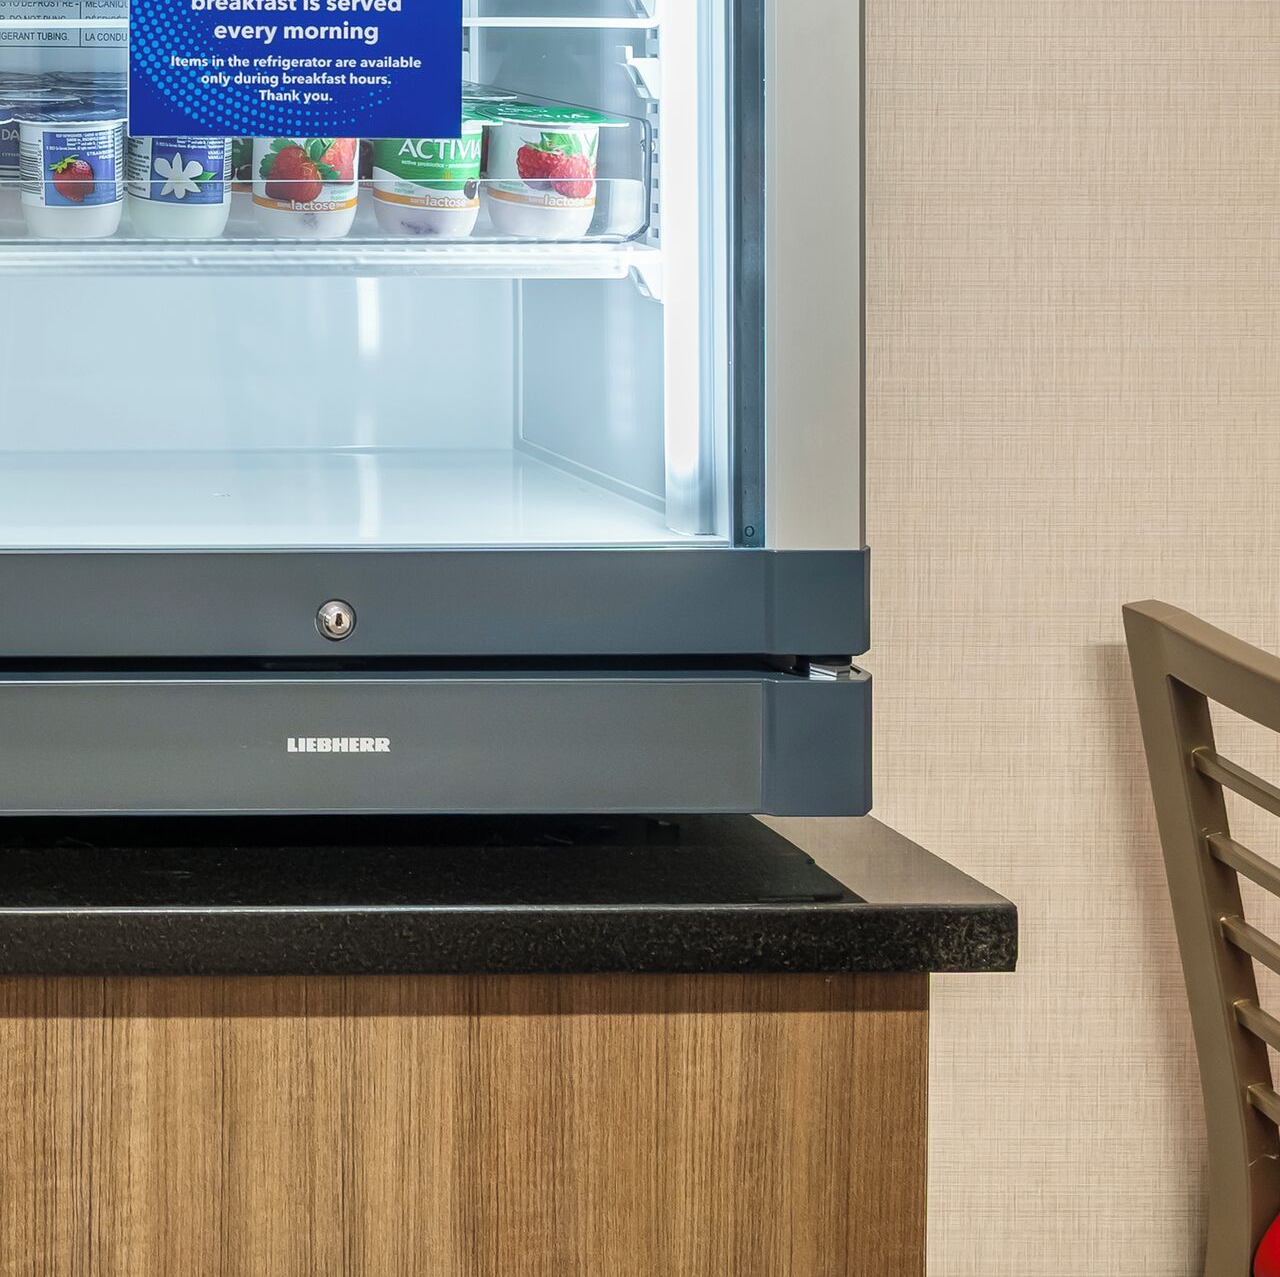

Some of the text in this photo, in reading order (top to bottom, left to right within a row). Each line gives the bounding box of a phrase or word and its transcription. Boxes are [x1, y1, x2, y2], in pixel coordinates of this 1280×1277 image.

[37, 32, 70, 41] TUBING.
[85, 33, 95, 42] LA
[213, 22, 379, 45] every morning
[170, 55, 422, 70] Items in the refrigerator are available
[200, 72, 392, 88] only during breakfast hours.
[258, 89, 333, 104] Thank you.
[291, 199, 336, 211] lactose
[287, 737, 391, 753] LIEBHERR
